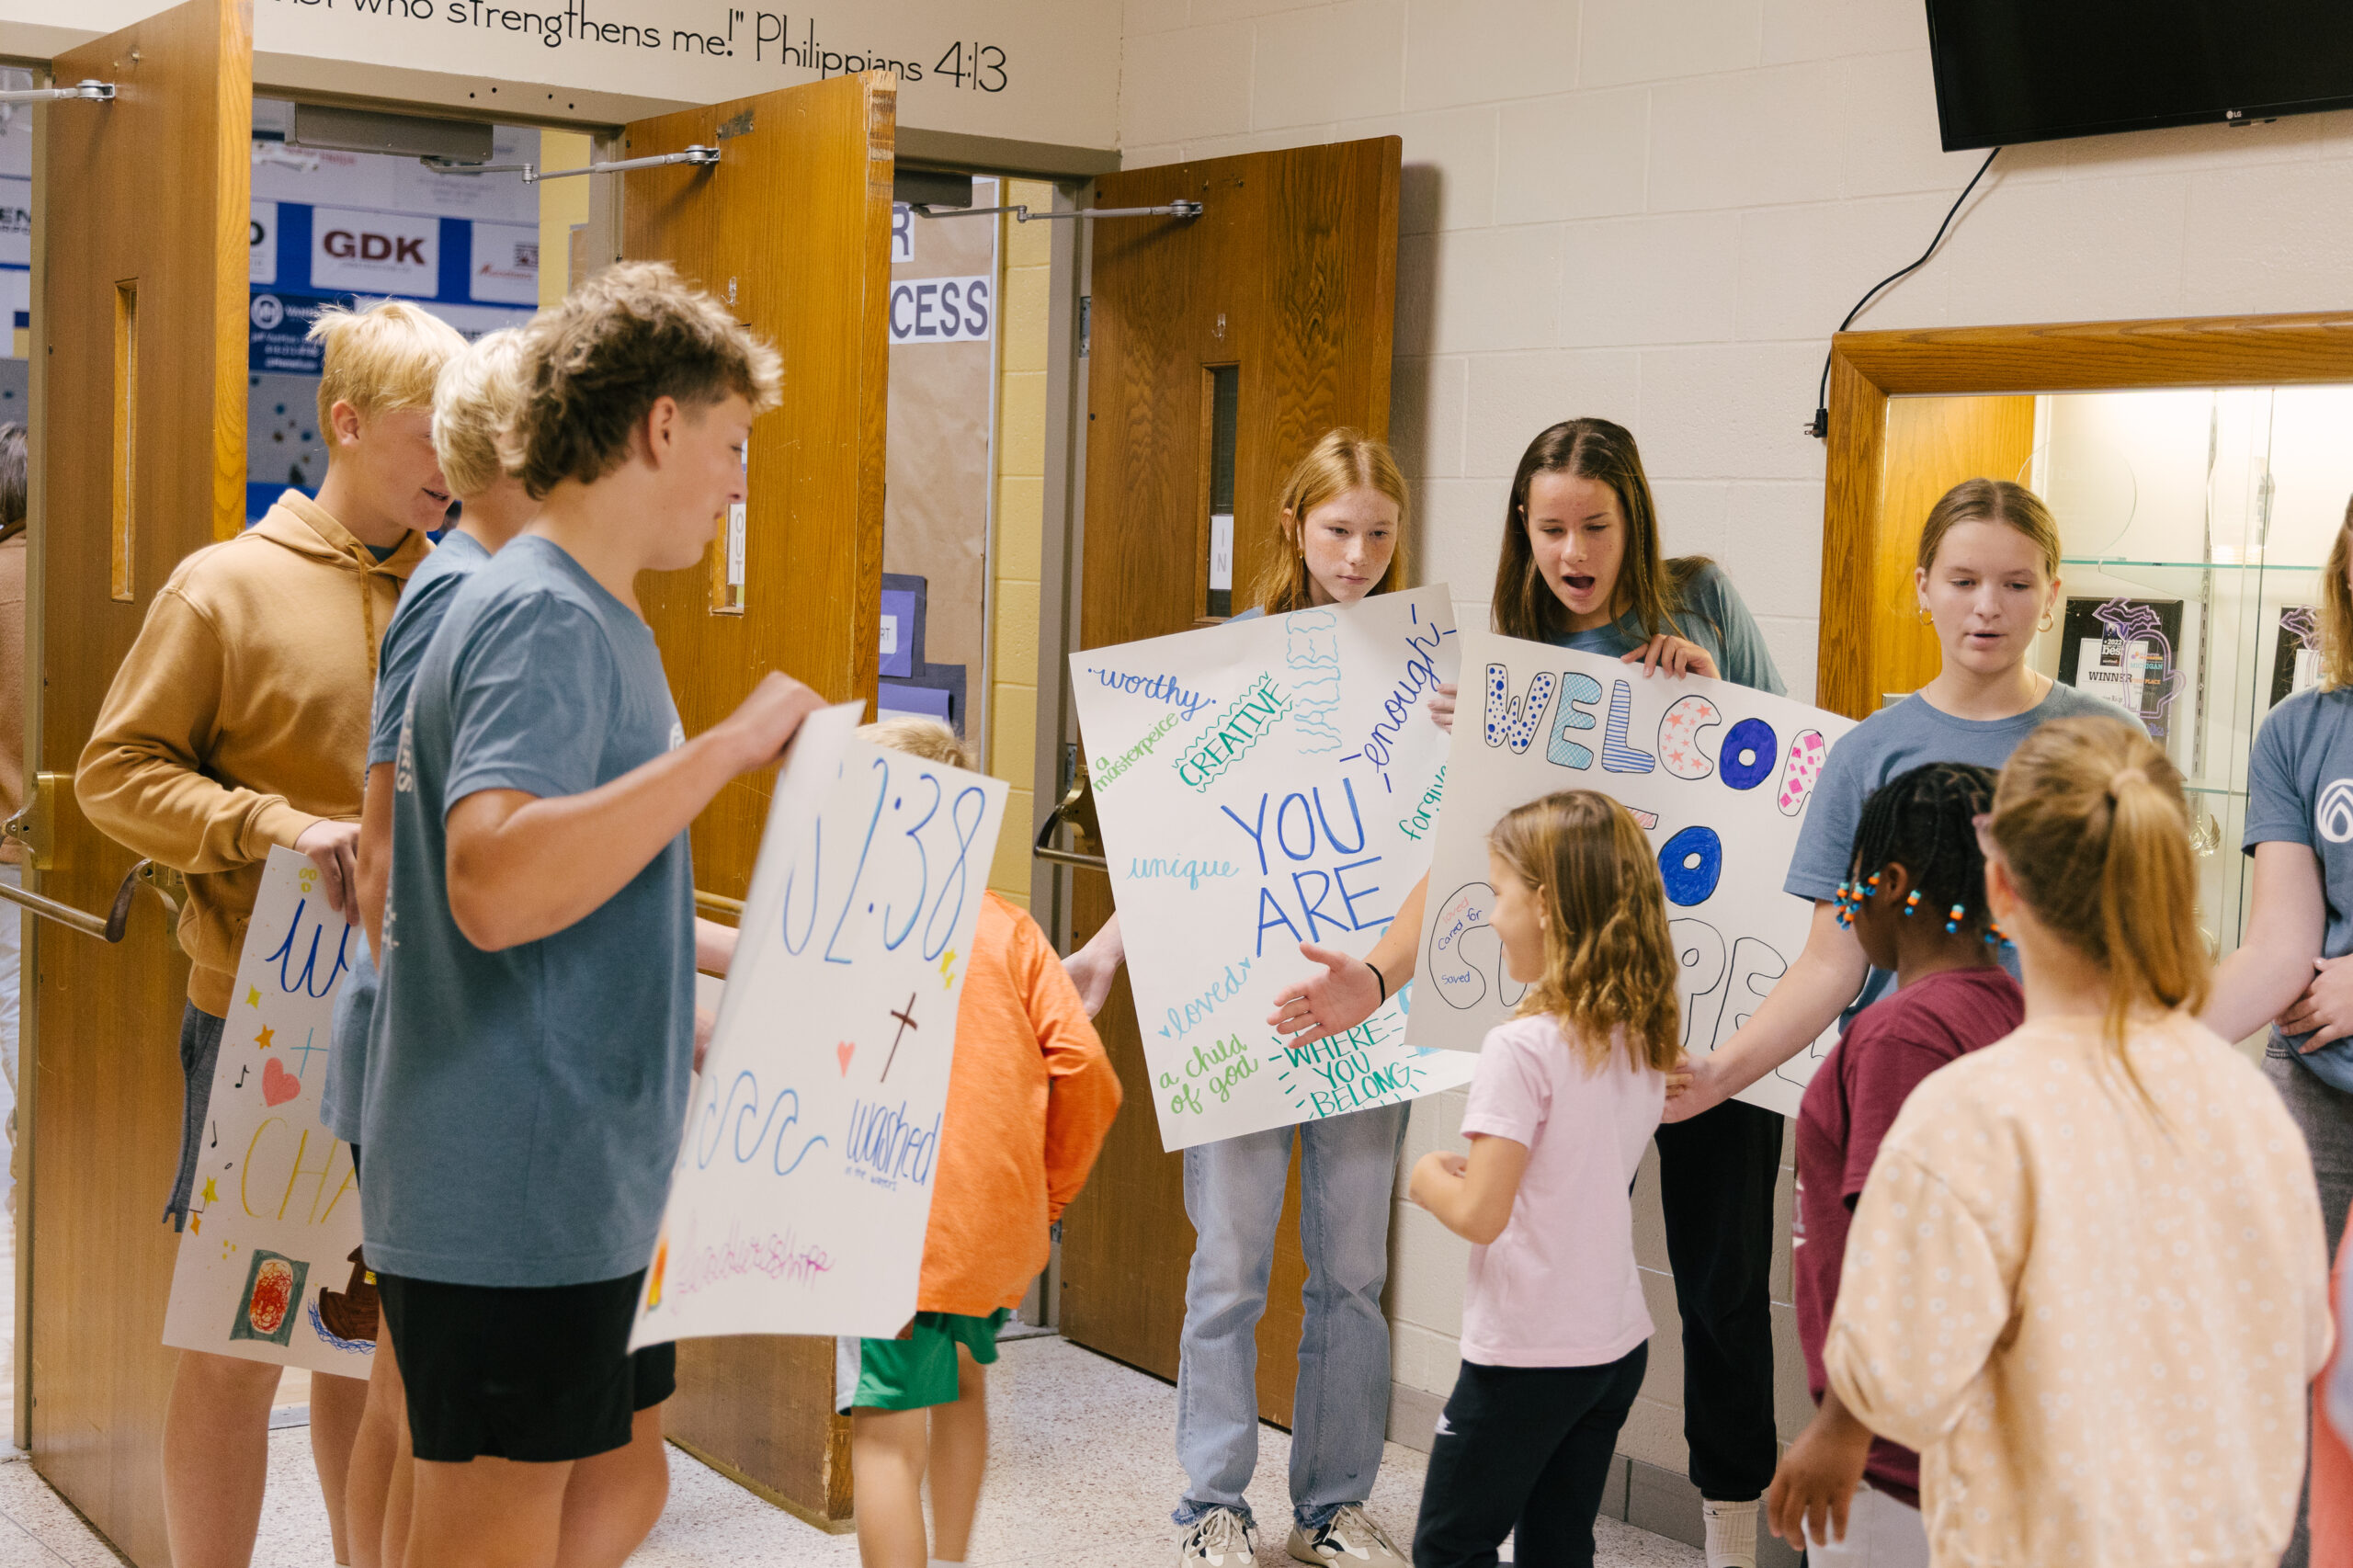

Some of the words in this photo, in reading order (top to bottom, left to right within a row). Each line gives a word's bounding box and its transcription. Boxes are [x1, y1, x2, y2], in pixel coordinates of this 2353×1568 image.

[447, 0, 661, 48] strengthens
[673, 8, 745, 57] me!"
[756, 11, 923, 82] Philippians
[933, 41, 1007, 92] 4:13
[323, 230, 426, 267] GDK
[890, 279, 988, 339] CESS
[1093, 669, 1211, 722] worthy
[1364, 622, 1441, 774] enough
[2088, 671, 2132, 683] WINNER
[1179, 678, 1291, 787] CREATIVE
[1095, 756, 1110, 771] a
[1221, 778, 1365, 876] YOU
[1127, 853, 1240, 890] unique
[1624, 805, 1722, 907] O
[1256, 856, 1395, 958] ARE
[1438, 919, 1463, 950] Cared
[1465, 907, 1483, 921] for
[1167, 966, 1247, 1041] loved
[1441, 971, 1471, 985] Saved
[1159, 1072, 1179, 1089] a
[1186, 1033, 1247, 1077] child
[1283, 1017, 1391, 1068] WHERE
[1312, 1051, 1370, 1089] YOU
[1170, 1083, 1204, 1115] of
[1209, 1054, 1258, 1103] god
[1310, 1062, 1411, 1118] BELONG
[847, 1098, 941, 1186] washed
